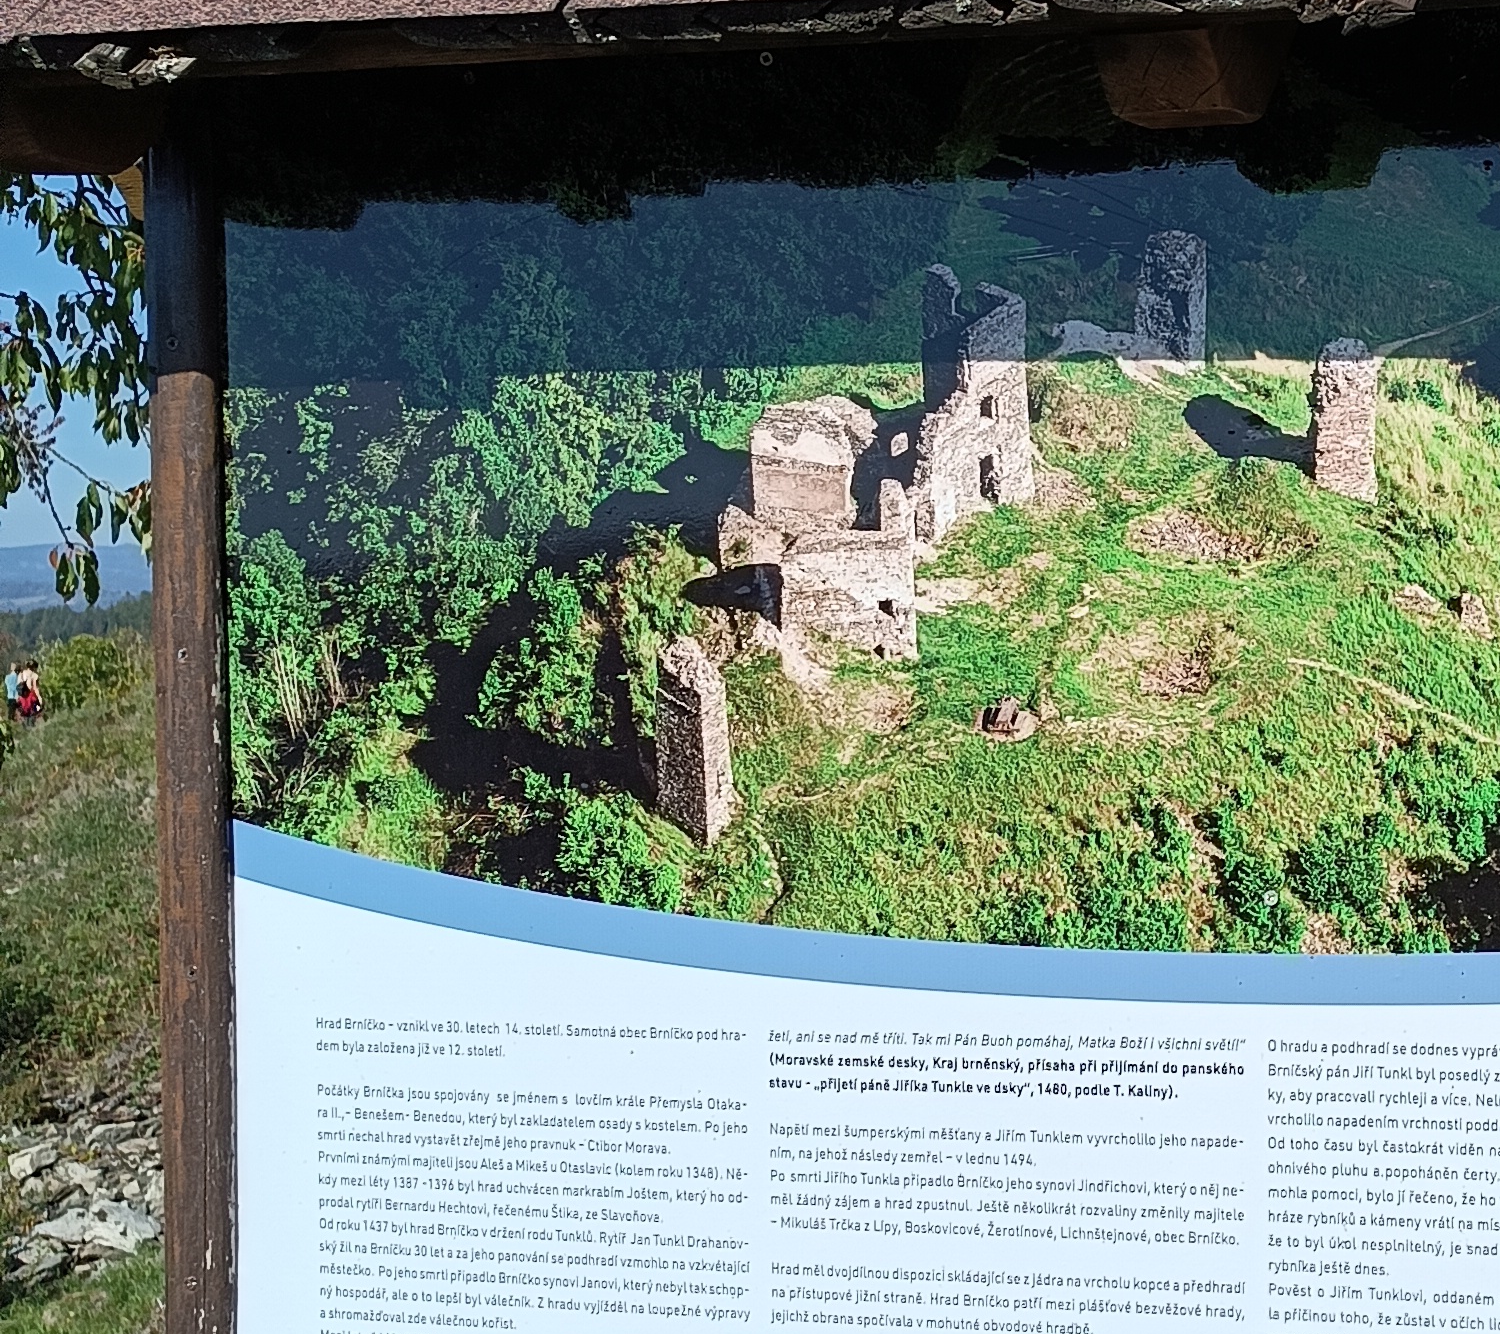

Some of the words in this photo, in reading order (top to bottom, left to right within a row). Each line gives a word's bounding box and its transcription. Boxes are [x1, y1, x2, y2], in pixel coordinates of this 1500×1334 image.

[316, 1039, 340, 1052] dem
[342, 1039, 365, 1056] byla
[367, 1041, 416, 1055] založena
[432, 1045, 446, 1056] ve
[467, 1044, 506, 1057] století.
[1267, 1038, 1277, 1052] O
[1280, 1039, 1318, 1053] hradu
[1320, 1043, 1328, 1054] a
[1331, 1040, 1390, 1057] podhradí
[1392, 1044, 1407, 1056] se
[1410, 1042, 1459, 1057] dodnes
[769, 1051, 834, 1067] (Moravské
[837, 1054, 885, 1068] zemské
[887, 1055, 929, 1073] desky,
[932, 1056, 958, 1073] Kraj
[961, 1056, 1024, 1075] brněnský,
[1027, 1058, 1076, 1075] přísaha
[1079, 1058, 1097, 1076] při
[1100, 1059, 1160, 1077] přijímání
[1162, 1061, 1178, 1074] do
[1181, 1061, 1245, 1078] panského
[769, 1122, 810, 1139] Napětí
[812, 1124, 841, 1137] mezi
[843, 1124, 925, 1143] šumperskými
[928, 1127, 982, 1145] měšťany
[984, 1131, 992, 1142] a
[994, 1128, 1026, 1143] Jiřím
[1029, 1129, 1083, 1145] Tunklem
[1086, 1132, 1156, 1148] vyvrcholilo
[1158, 1133, 1187, 1150] jeho
[1190, 1134, 1244, 1151] napade-
[1267, 1136, 1286, 1150] Od
[1290, 1137, 1319, 1151] toho
[1323, 1138, 1354, 1152] času
[1358, 1138, 1379, 1156] byl
[1447, 1142, 1484, 1157] viděn
[318, 1195, 354, 1211] prodal
[355, 1197, 383, 1213] rytíři
[384, 1198, 436, 1213] Bernardu
[438, 1200, 490, 1218] Hechtovi,
[492, 1203, 549, 1219] řečenému
[551, 1203, 583, 1222] Štika,
[585, 1210, 599, 1221] ze
